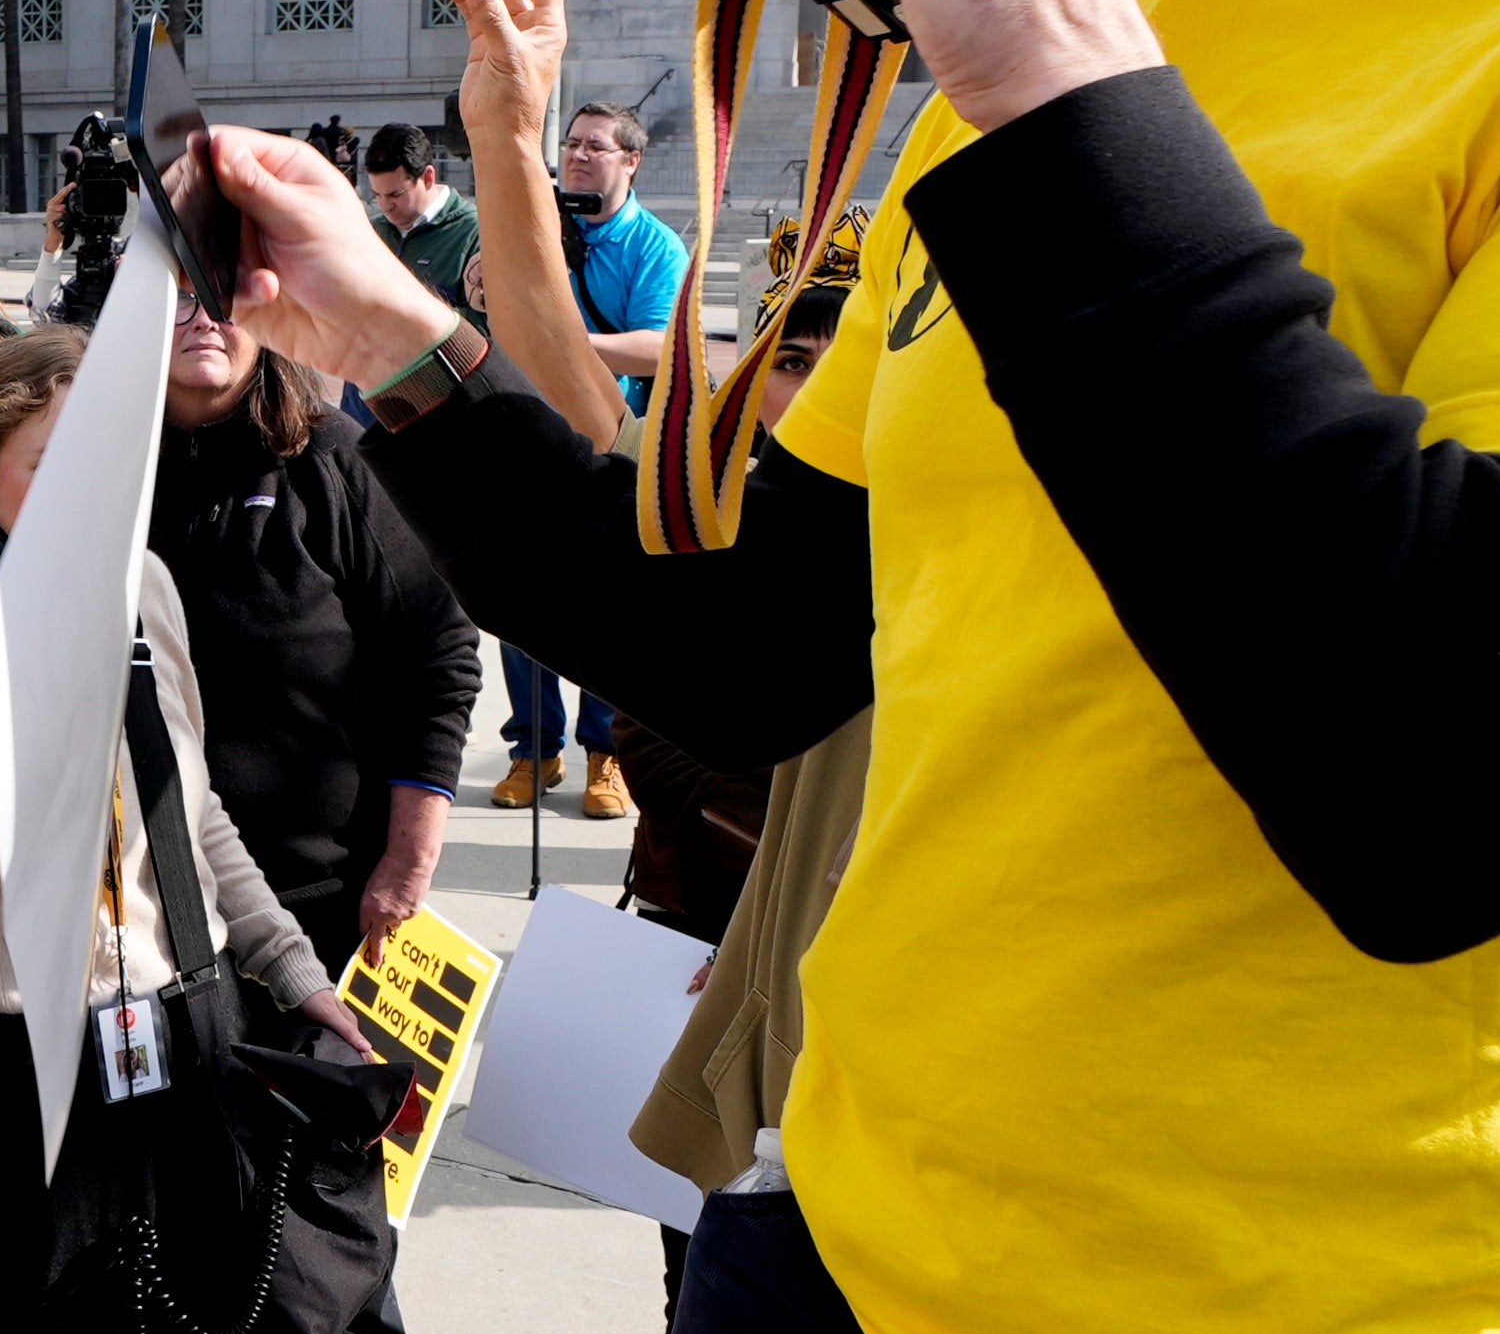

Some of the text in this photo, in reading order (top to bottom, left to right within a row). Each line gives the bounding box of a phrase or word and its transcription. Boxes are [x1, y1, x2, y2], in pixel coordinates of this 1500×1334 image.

[401, 939, 440, 979] can't
[387, 965, 412, 994] our
[378, 995, 429, 1047] way to
